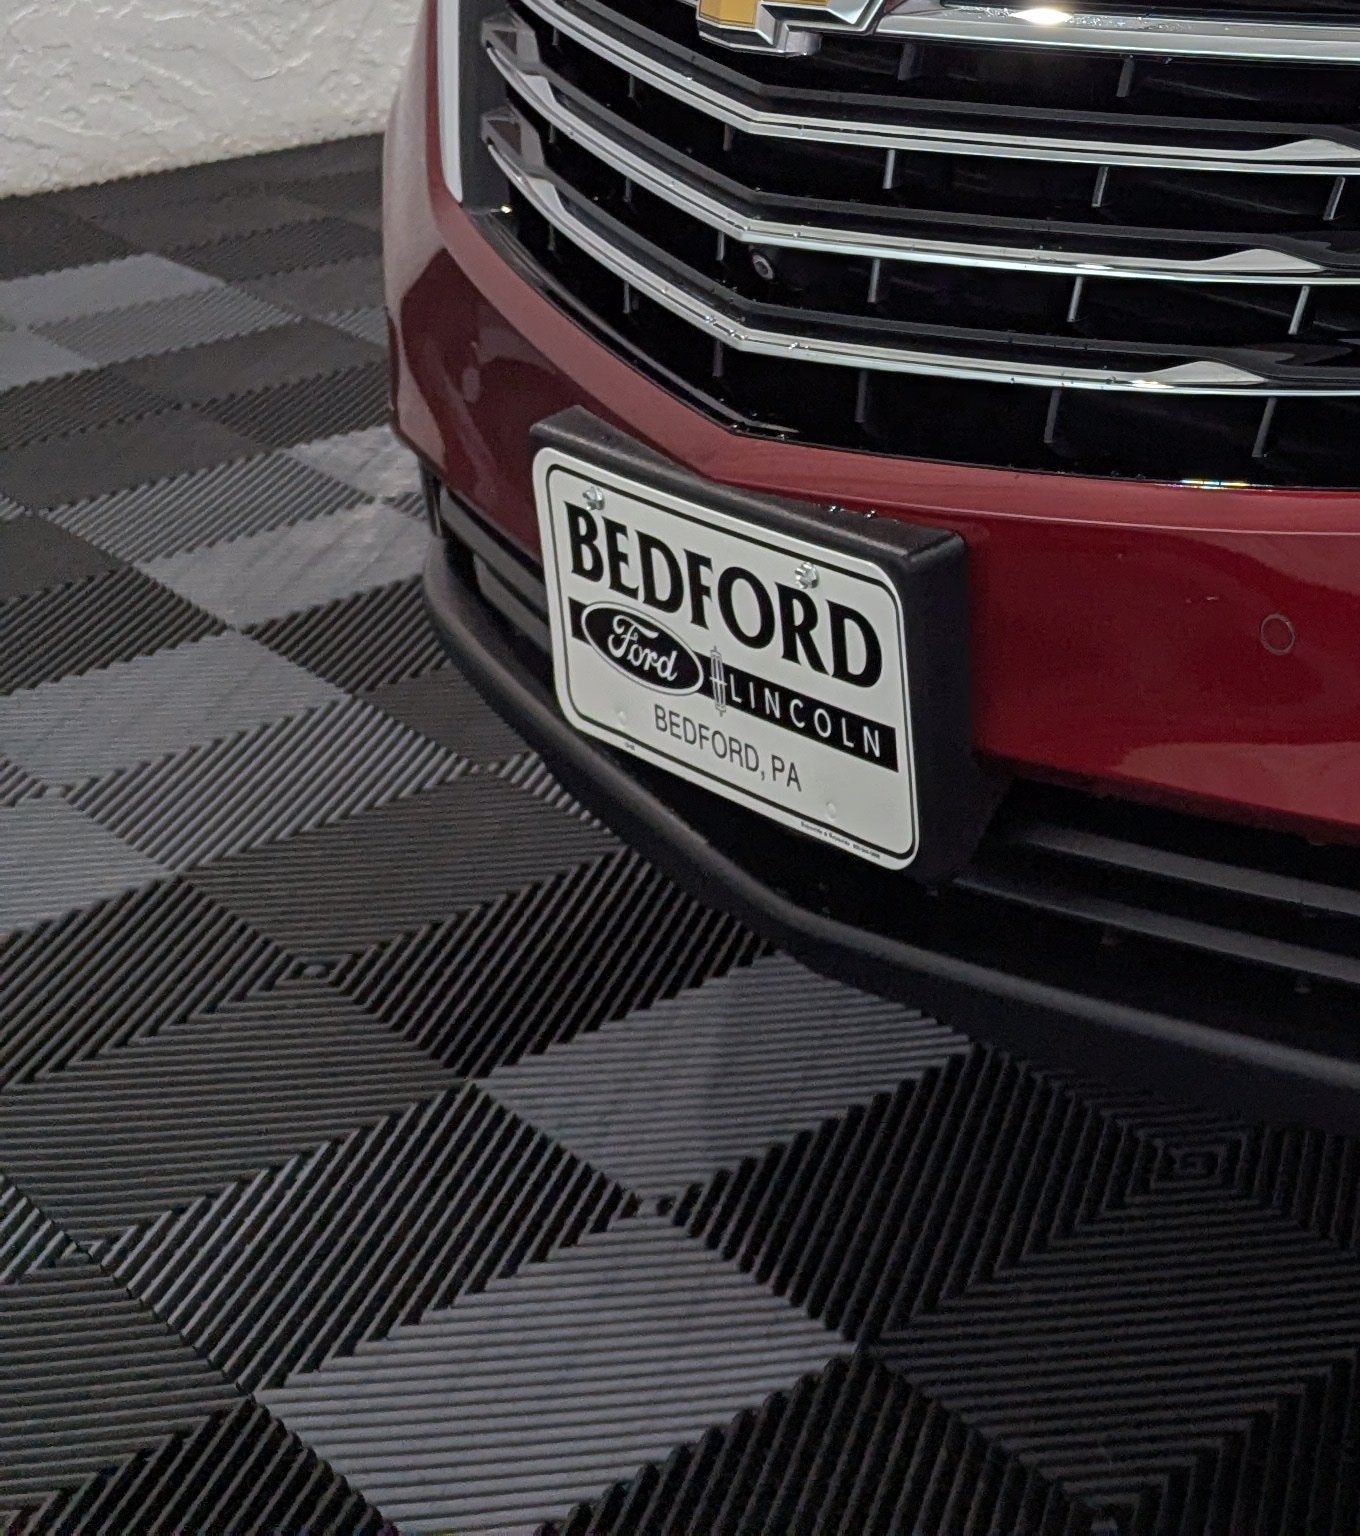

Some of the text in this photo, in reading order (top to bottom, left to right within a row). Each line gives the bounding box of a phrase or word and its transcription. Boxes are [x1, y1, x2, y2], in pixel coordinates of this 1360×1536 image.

[564, 501, 883, 688] BEDFORD
[607, 613, 680, 682] Ford
[653, 703, 802, 792] BEDFORD, PA
[729, 672, 882, 759] LINCOLN
